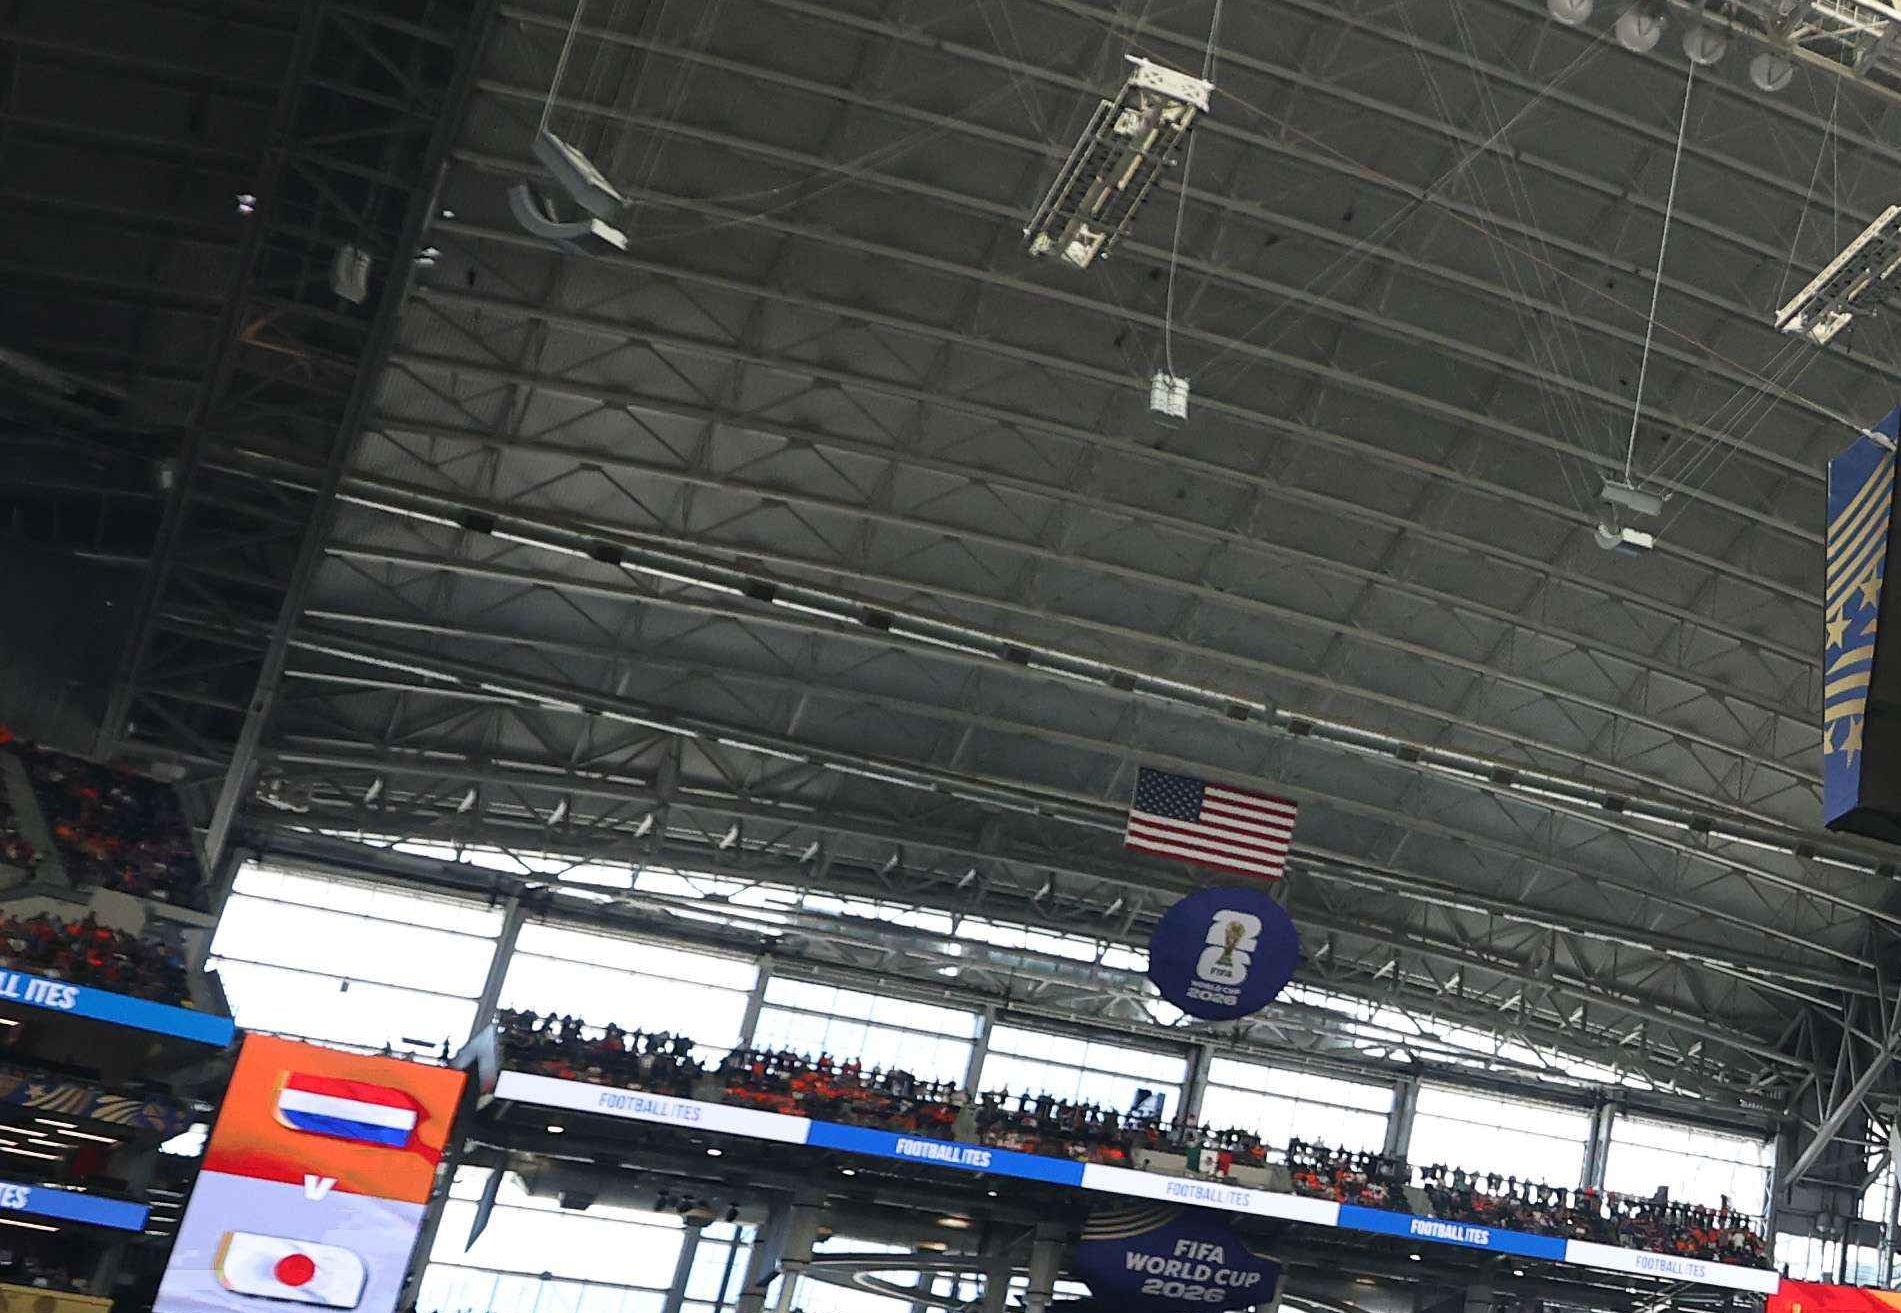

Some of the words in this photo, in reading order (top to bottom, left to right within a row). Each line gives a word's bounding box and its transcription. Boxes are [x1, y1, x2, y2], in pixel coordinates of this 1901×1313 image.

[1173, 1239, 1226, 1265] FIFA
[1126, 1251, 1211, 1280] WORLD
[1214, 1268, 1262, 1289] CUP
[1141, 1278, 1226, 1304] 2026
